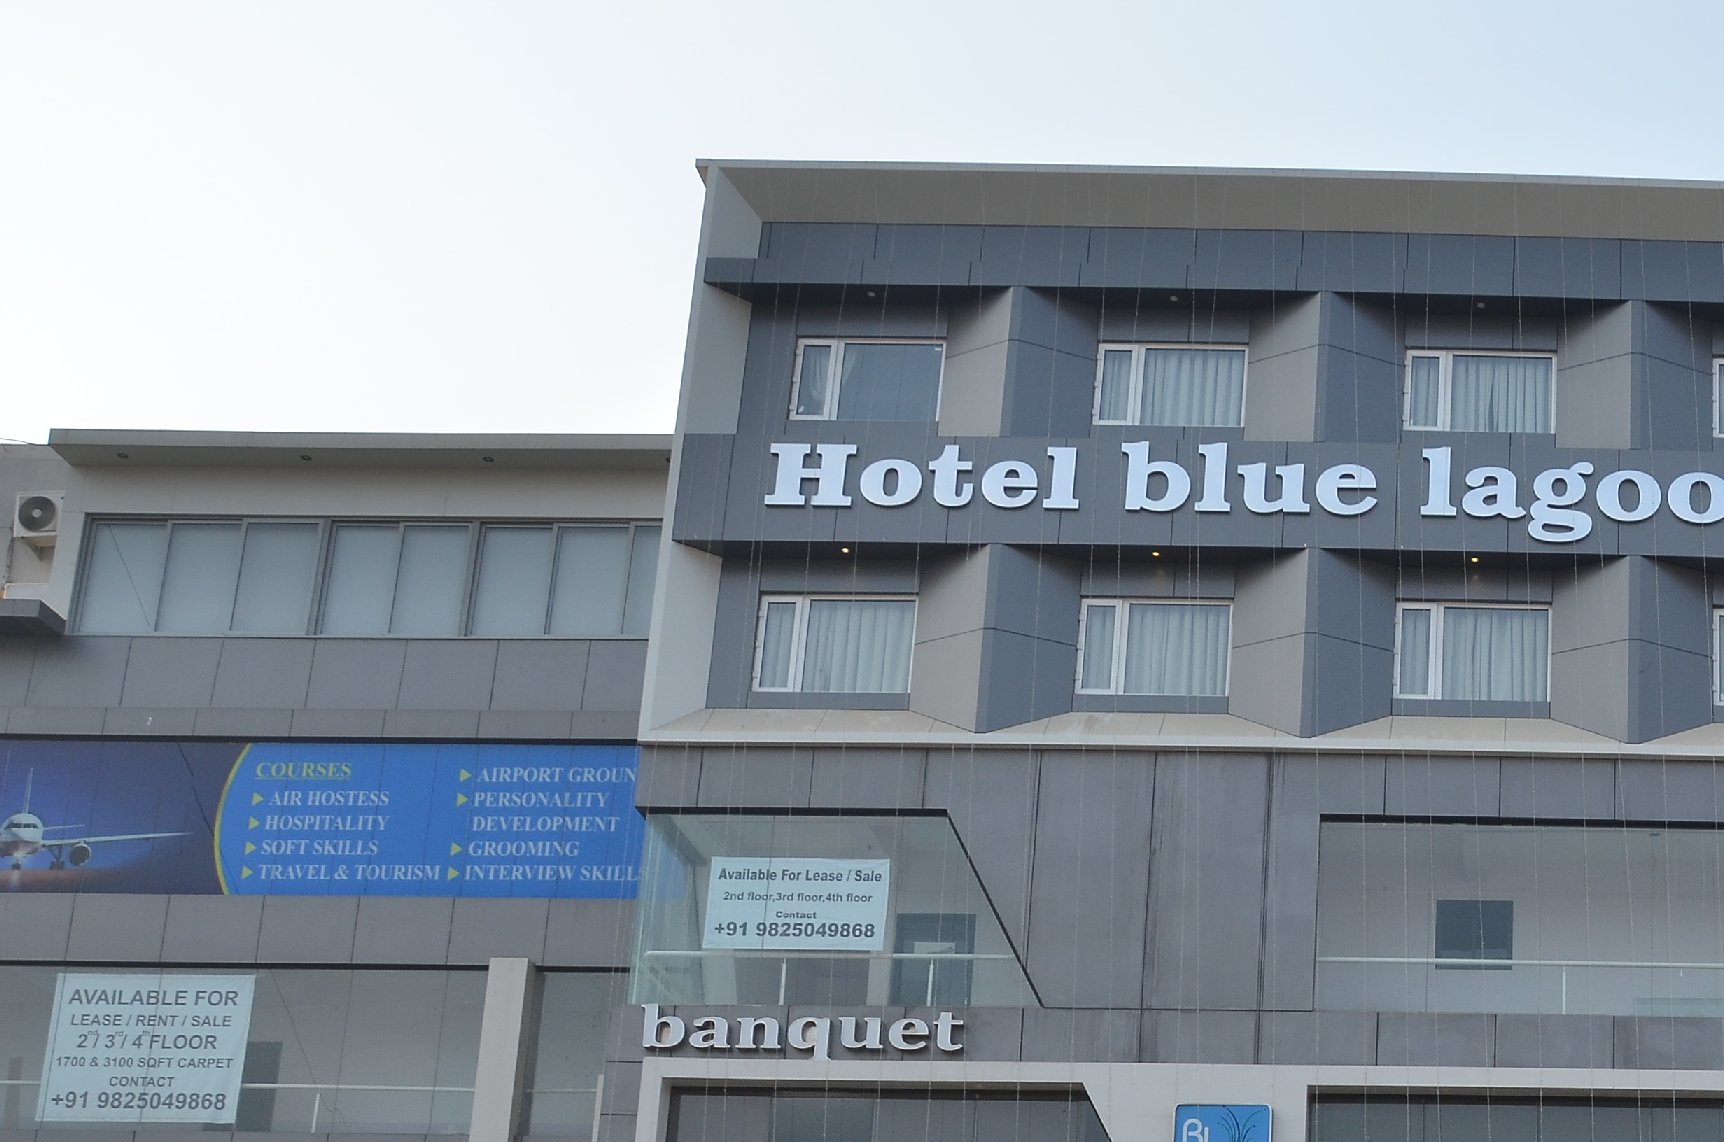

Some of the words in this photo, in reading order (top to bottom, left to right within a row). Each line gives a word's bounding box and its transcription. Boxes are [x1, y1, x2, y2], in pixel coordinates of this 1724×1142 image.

[764, 442, 1081, 510] Hotel
[1121, 441, 1379, 516] blue
[255, 762, 352, 780] COURSES
[477, 767, 563, 782] AIRPORT
[269, 791, 301, 805] AIR
[307, 791, 389, 805] HOSTESS
[473, 792, 609, 807] PERSONALITY
[265, 815, 389, 830] HOSPITALITY
[472, 816, 620, 831] DEVELOPMENT
[261, 839, 308, 854] SOFT
[312, 840, 378, 854] SKILLS
[468, 841, 580, 856] GROOMING
[259, 864, 329, 879] TRAVEL
[334, 864, 348, 879] &
[355, 864, 440, 879] TOURISM
[464, 865, 574, 880] INTERVIEW
[580, 865, 640, 880] SKILL
[718, 868, 777, 881] Available
[781, 869, 802, 881] For
[805, 870, 843, 882] Lease
[855, 870, 882, 882] Sale
[723, 891, 744, 900] 2nd
[846, 894, 873, 902] floor
[775, 911, 817, 919] Contact
[714, 921, 748, 936] +91
[756, 922, 875, 938] 9825049868
[68, 989, 188, 1006] AVAILABLE
[194, 990, 239, 1006] FOR
[70, 1014, 122, 1026] LEASE
[136, 1015, 178, 1027] RENT
[191, 1015, 232, 1027] SALE
[642, 1003, 964, 1061] banquet
[150, 1034, 217, 1049] FLOOR
[57, 1057, 86, 1067] 1700
[90, 1057, 99, 1067] &
[103, 1057, 133, 1067] 3100
[137, 1057, 173, 1069] SQFT
[177, 1058, 233, 1068] CARPET
[109, 1076, 175, 1087] CONTACT
[51, 1091, 88, 1109] +91
[97, 1092, 226, 1110] 9825049868
